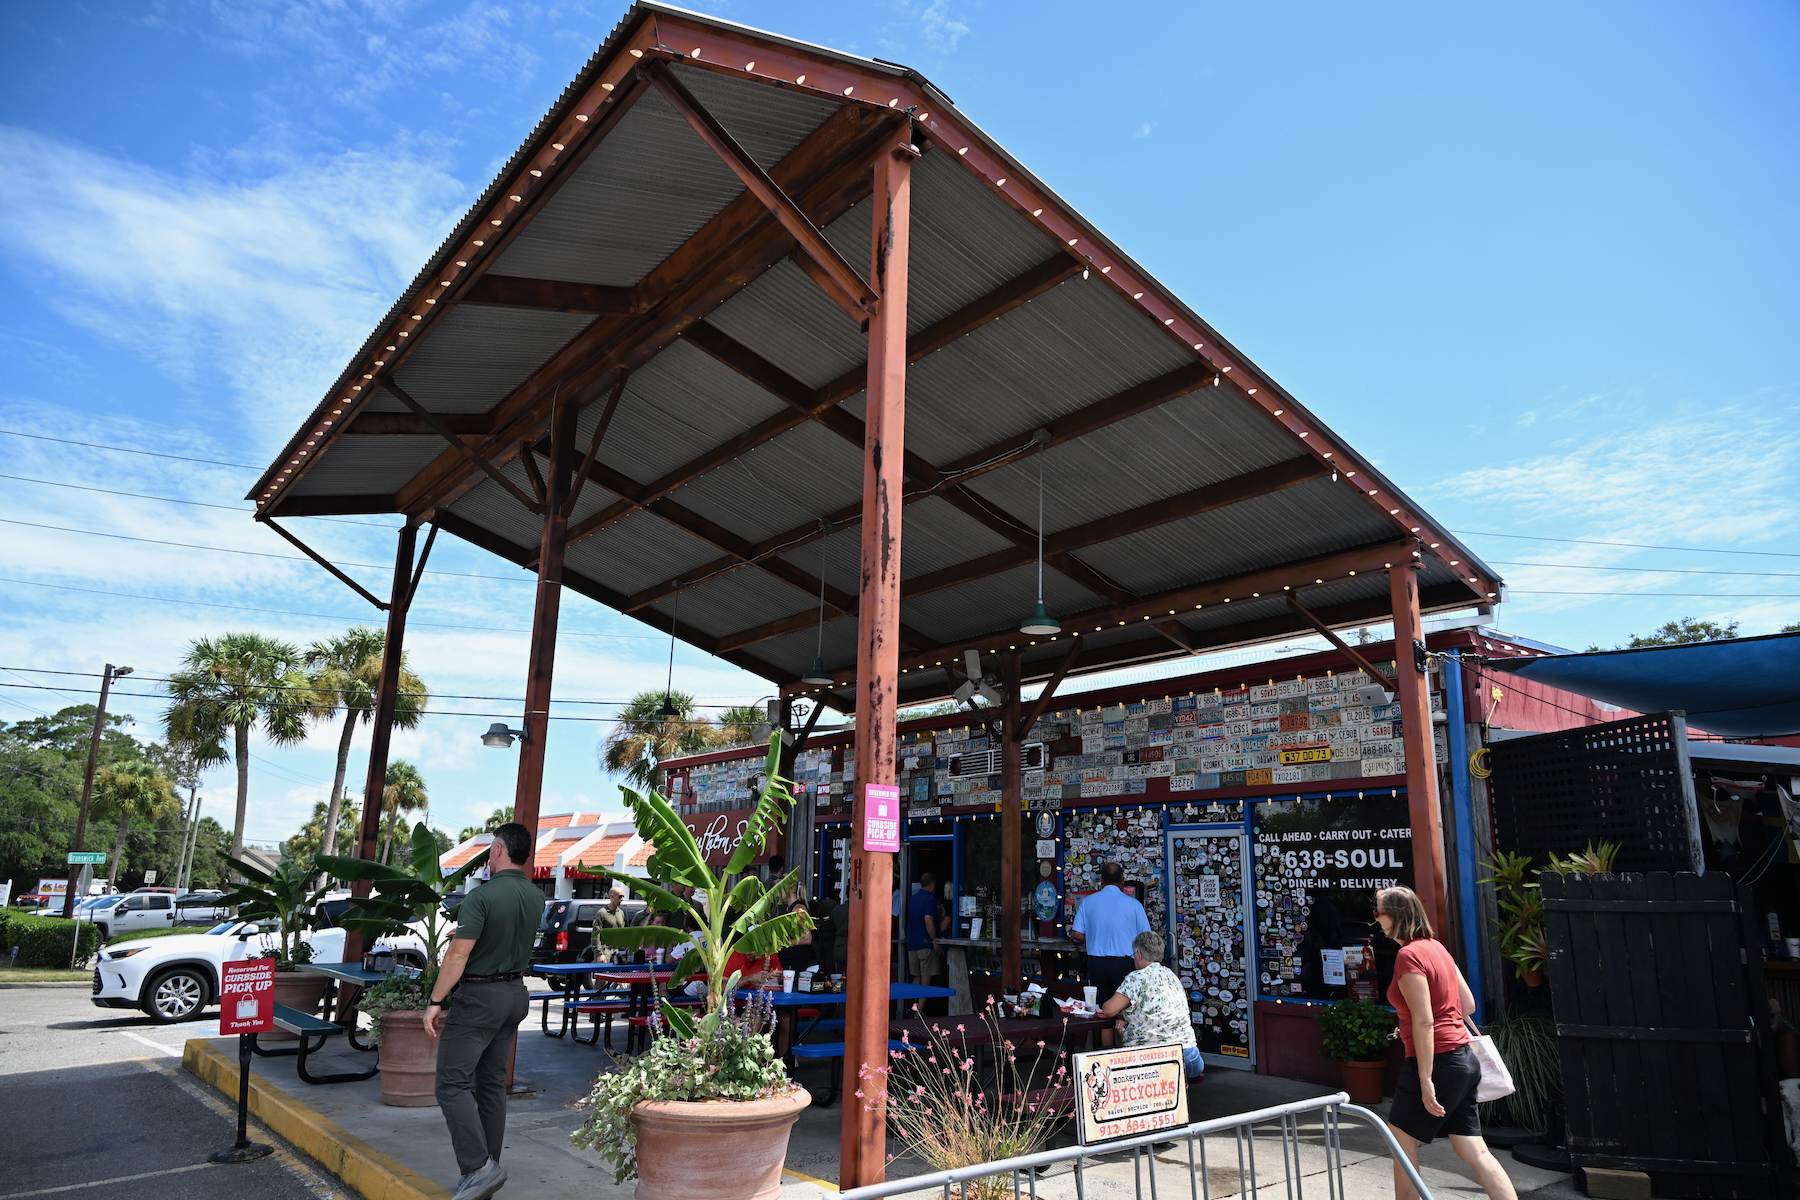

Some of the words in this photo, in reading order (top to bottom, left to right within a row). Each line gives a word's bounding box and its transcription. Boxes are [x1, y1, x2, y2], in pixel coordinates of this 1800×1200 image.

[867, 819, 897, 830] CURBSIDE
[686, 815, 732, 863] uthern
[867, 828, 897, 840] PICK-UP
[1259, 833, 1280, 842] CALL
[1282, 832, 1312, 842] AHEAD
[1319, 831, 1350, 841] CARRY
[1352, 830, 1372, 840] OUT
[1380, 828, 1412, 839] CATER
[69, 854, 95, 862] Brunswick
[96, 854, 105, 862] Ave
[1286, 849, 1403, 869] 638-SOUL
[1288, 879, 1330, 888] DINE-IN
[1340, 879, 1397, 888] DELIVERY
[225, 972, 272, 982] CURBSIDE
[224, 982, 254, 993] PICK
[255, 980, 273, 991] UP
[1110, 1056, 1136, 1065] PARKING
[1139, 1052, 1168, 1061] COURTESY
[1113, 1069, 1160, 1084] monkeywrench
[1112, 1081, 1176, 1104] BICYCLES
[1108, 1107, 1123, 1115] sales
[1127, 1103, 1148, 1112] service
[1099, 1114, 1176, 1136] 912.634.5551
